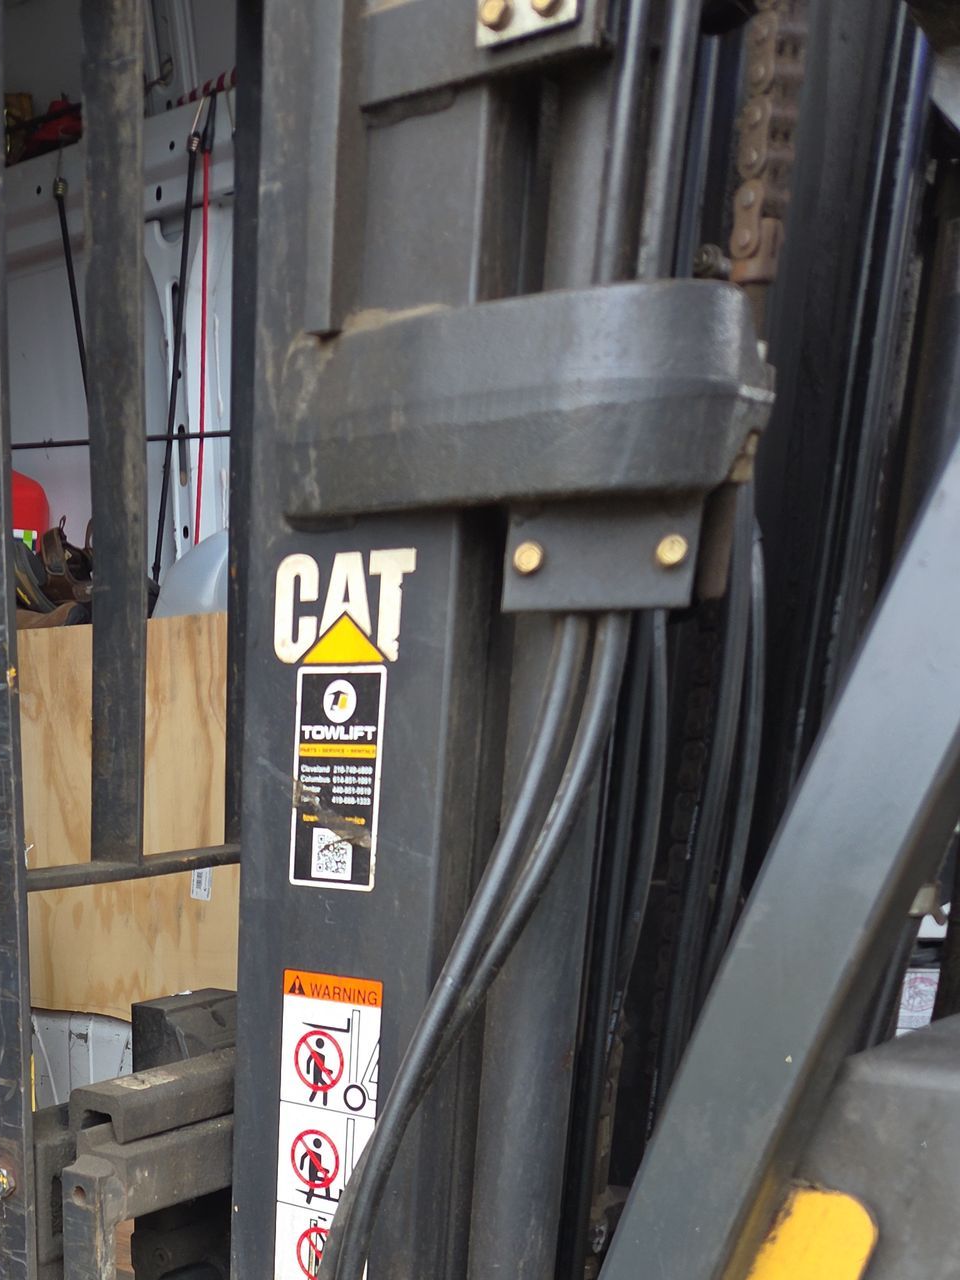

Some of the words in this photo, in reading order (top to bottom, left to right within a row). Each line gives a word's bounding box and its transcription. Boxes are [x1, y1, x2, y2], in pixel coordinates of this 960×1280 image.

[273, 547, 417, 664] CAT
[301, 725, 377, 741] TOWLIFT
[309, 982, 378, 1006] WARNING
